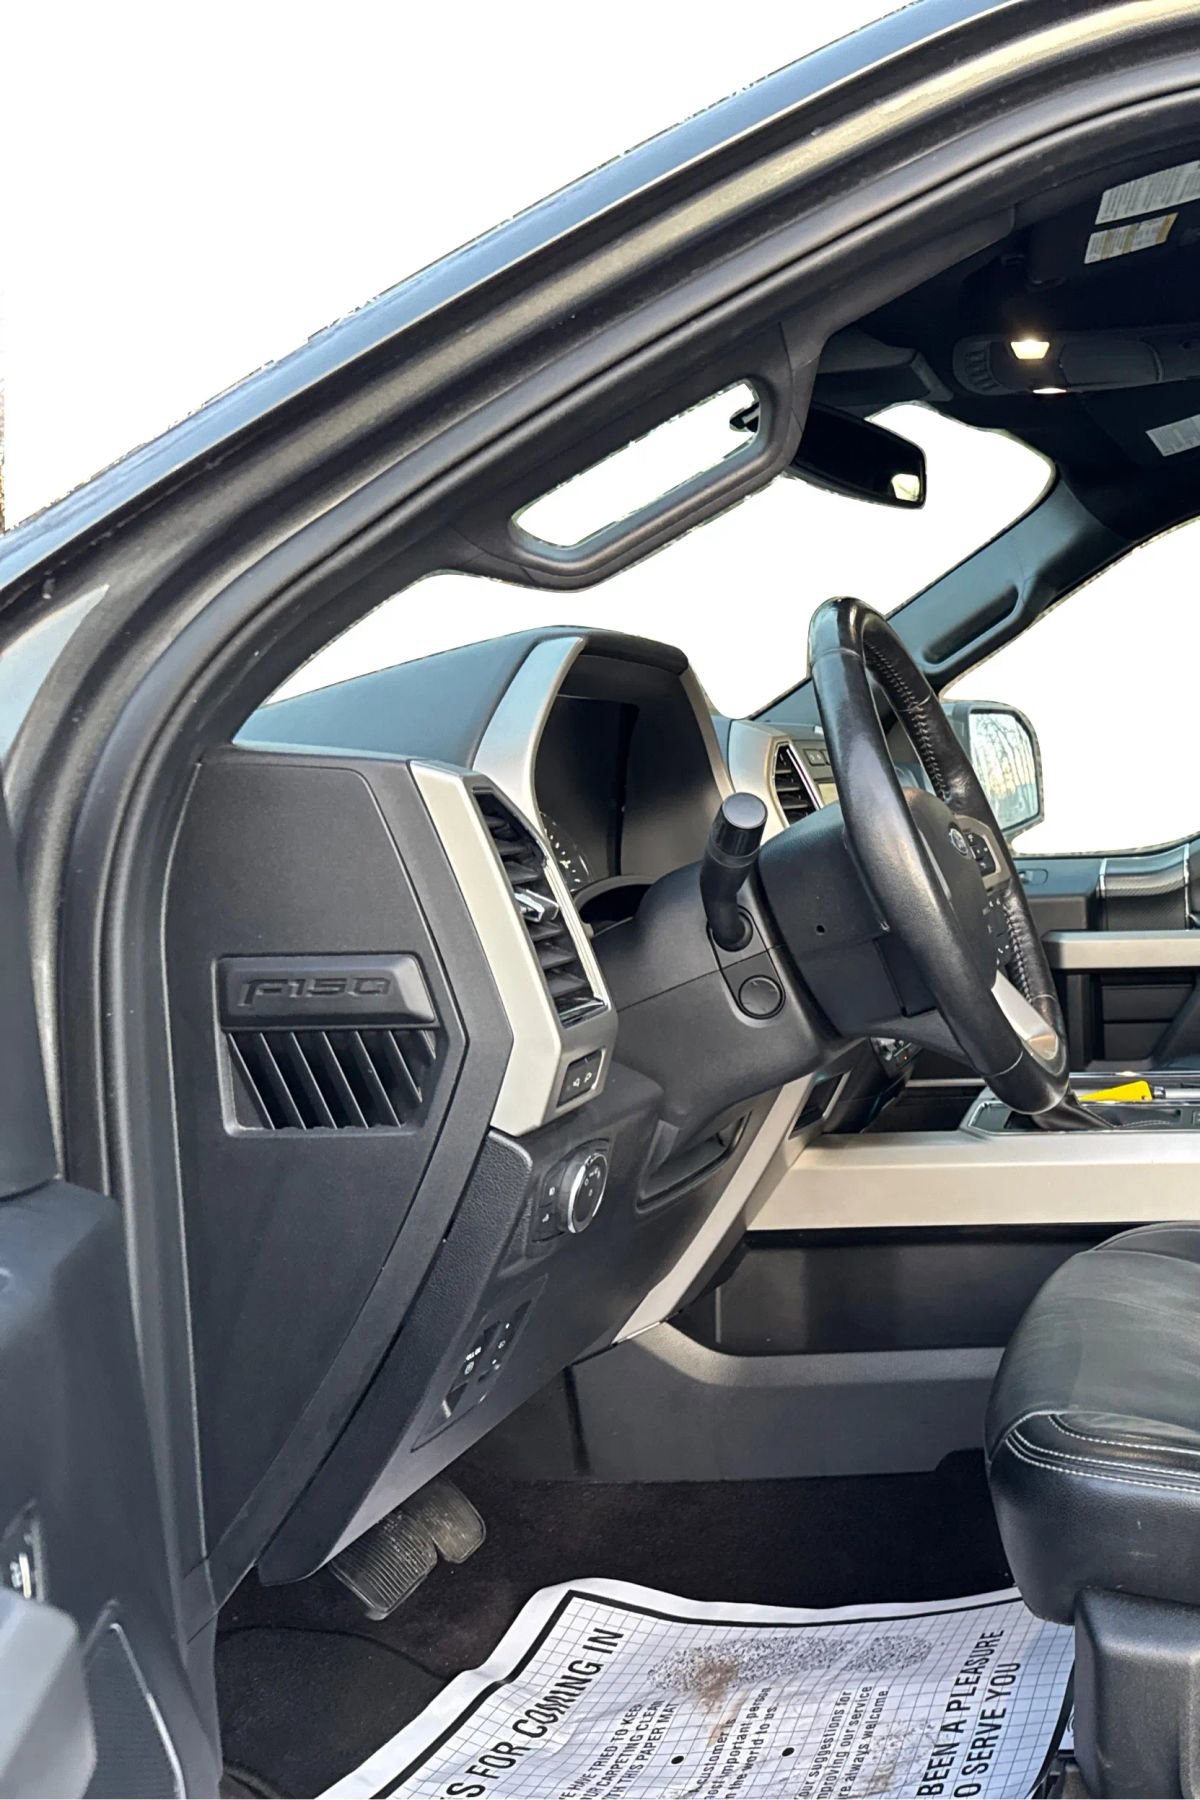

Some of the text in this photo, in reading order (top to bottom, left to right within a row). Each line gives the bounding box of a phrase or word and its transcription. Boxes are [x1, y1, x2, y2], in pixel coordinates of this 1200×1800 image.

[465, 1741, 530, 1780] FOR
[512, 1660, 604, 1739] COMING
[583, 1628, 624, 1655] IN
[617, 1764, 644, 1785] THIS
[635, 1727, 666, 1761] PAPER
[656, 1703, 679, 1723] MAT
[716, 1722, 752, 1779] important
[746, 1687, 772, 1719] person
[809, 1709, 845, 1777] suggestions
[834, 1691, 852, 1706] for
[840, 1729, 855, 1747] our
[848, 1686, 872, 1726] service
[845, 1743, 870, 1782] always
[861, 1690, 888, 1740] welcome
[916, 1630, 1004, 1796] BEEN A PLEASURE
[962, 1708, 1006, 1776] SERVE
[985, 1662, 1021, 1704] YOU
[567, 1773, 597, 1791] HAVE
[588, 1745, 618, 1772] TRIED
[610, 1729, 629, 1743] TO
[596, 1735, 644, 1787] CARPETING
[697, 1732, 729, 1785] customer
[728, 1774, 748, 1790] the
[741, 1739, 764, 1772] world
[754, 1723, 771, 1735] to
